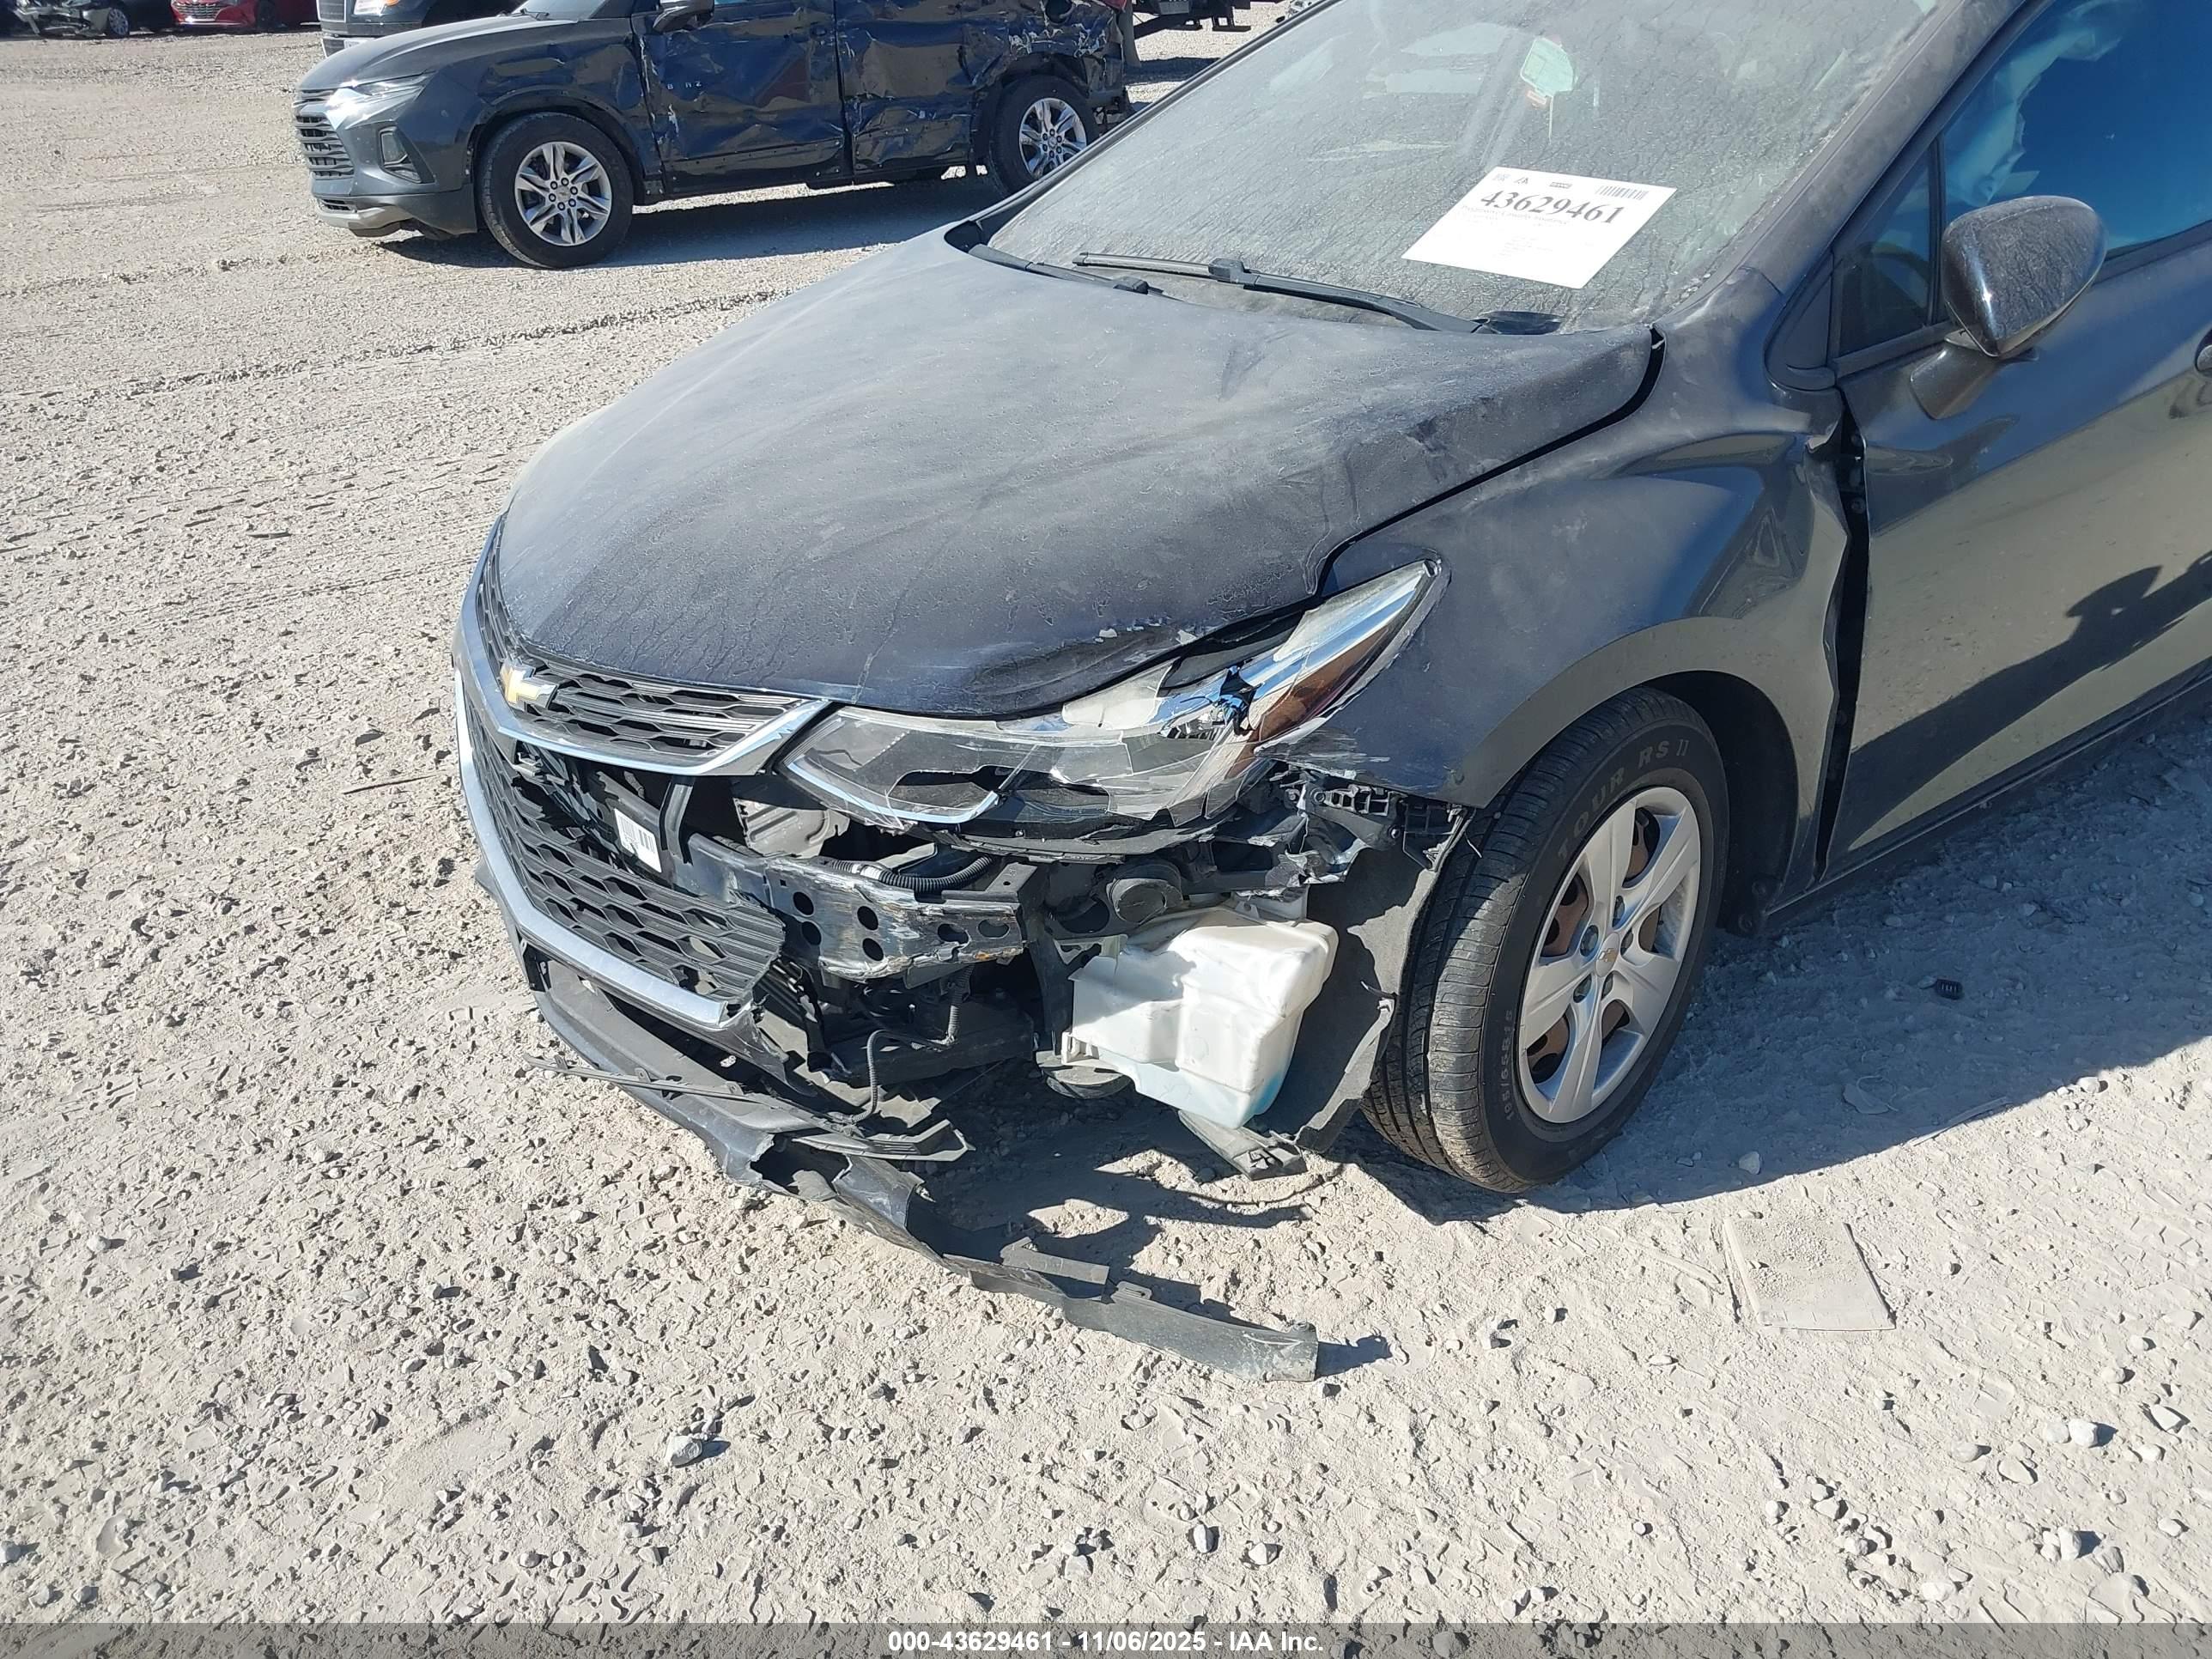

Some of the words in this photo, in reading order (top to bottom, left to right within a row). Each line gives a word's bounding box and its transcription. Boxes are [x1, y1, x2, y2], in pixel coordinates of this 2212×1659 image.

[1480, 190, 1625, 224] 43629461
[1558, 767, 1625, 860] TOUR
[1638, 740, 1669, 769] RS
